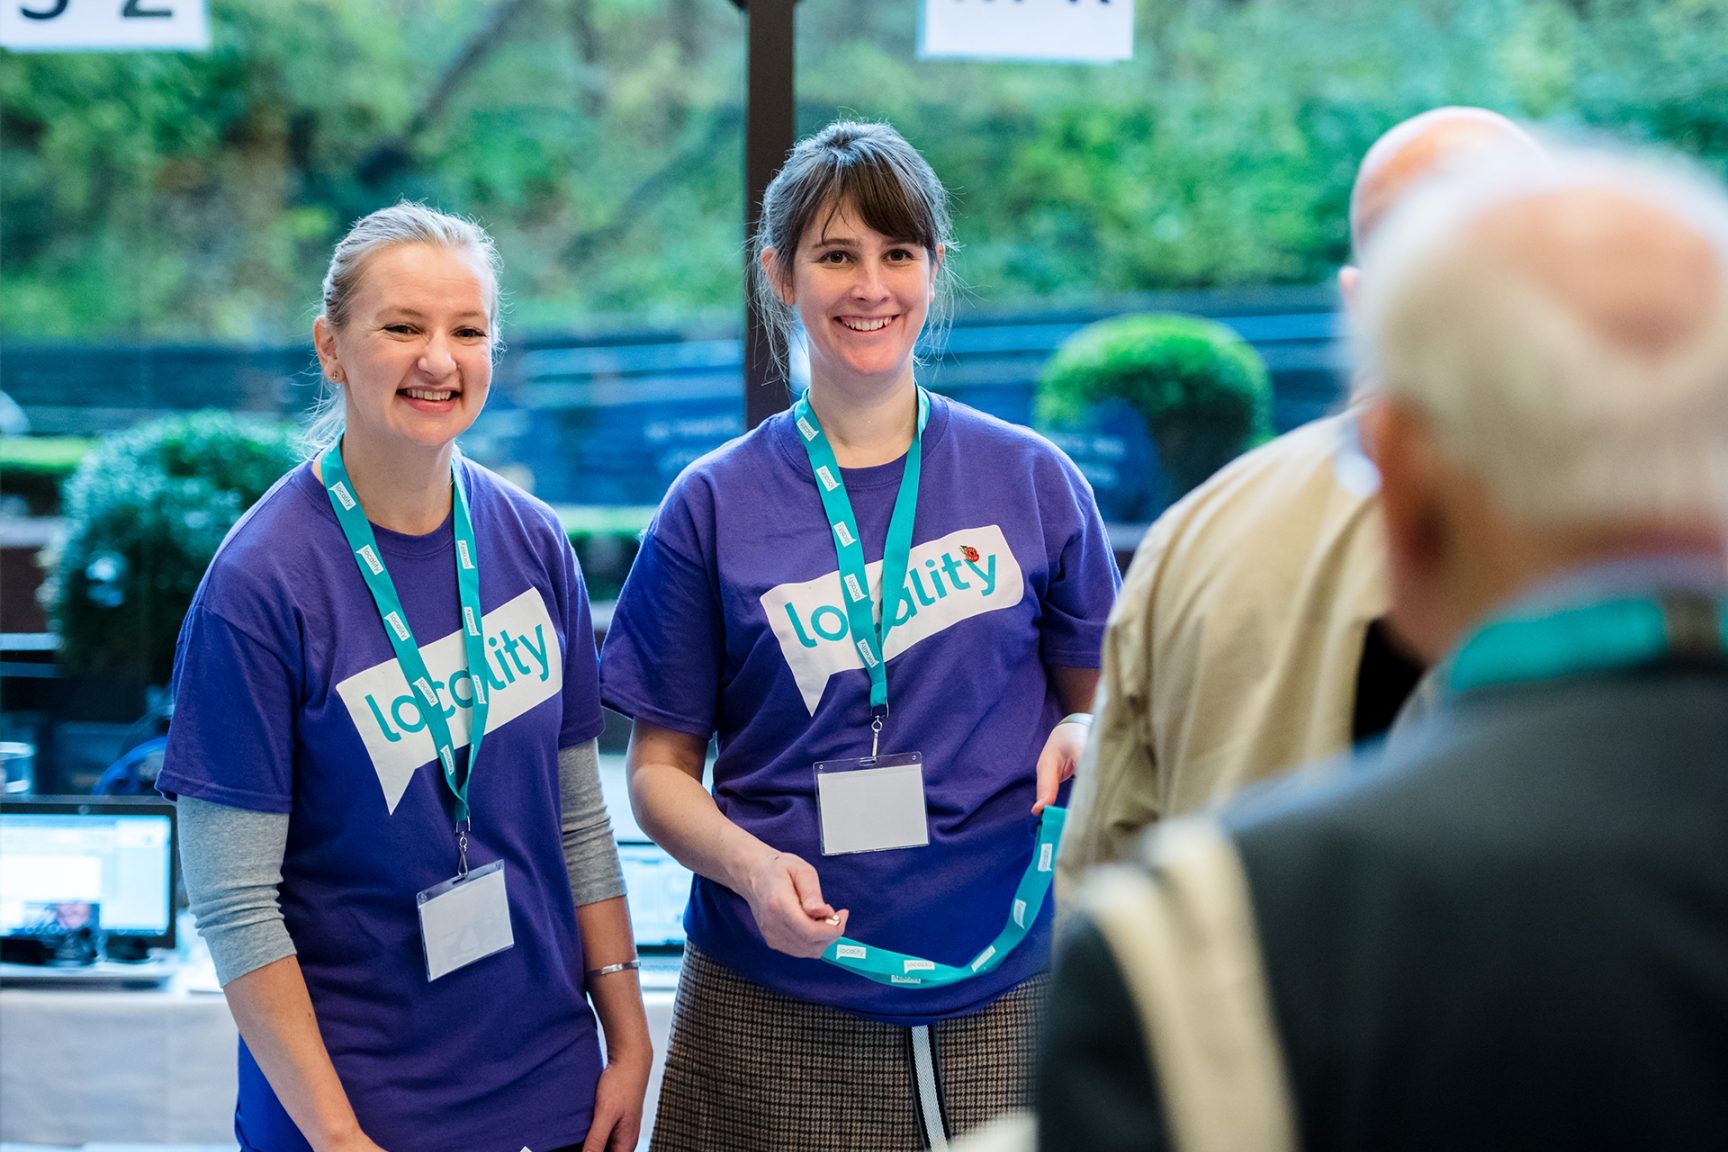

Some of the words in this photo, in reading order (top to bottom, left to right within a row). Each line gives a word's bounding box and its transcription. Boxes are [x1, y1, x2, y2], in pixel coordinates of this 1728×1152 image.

[335, 483, 353, 508] locality
[362, 547, 380, 572] locality
[844, 574, 860, 599] locality
[784, 552, 996, 648] loality
[388, 613, 408, 640] locality
[859, 641, 876, 666] locality
[418, 678, 436, 704] locality
